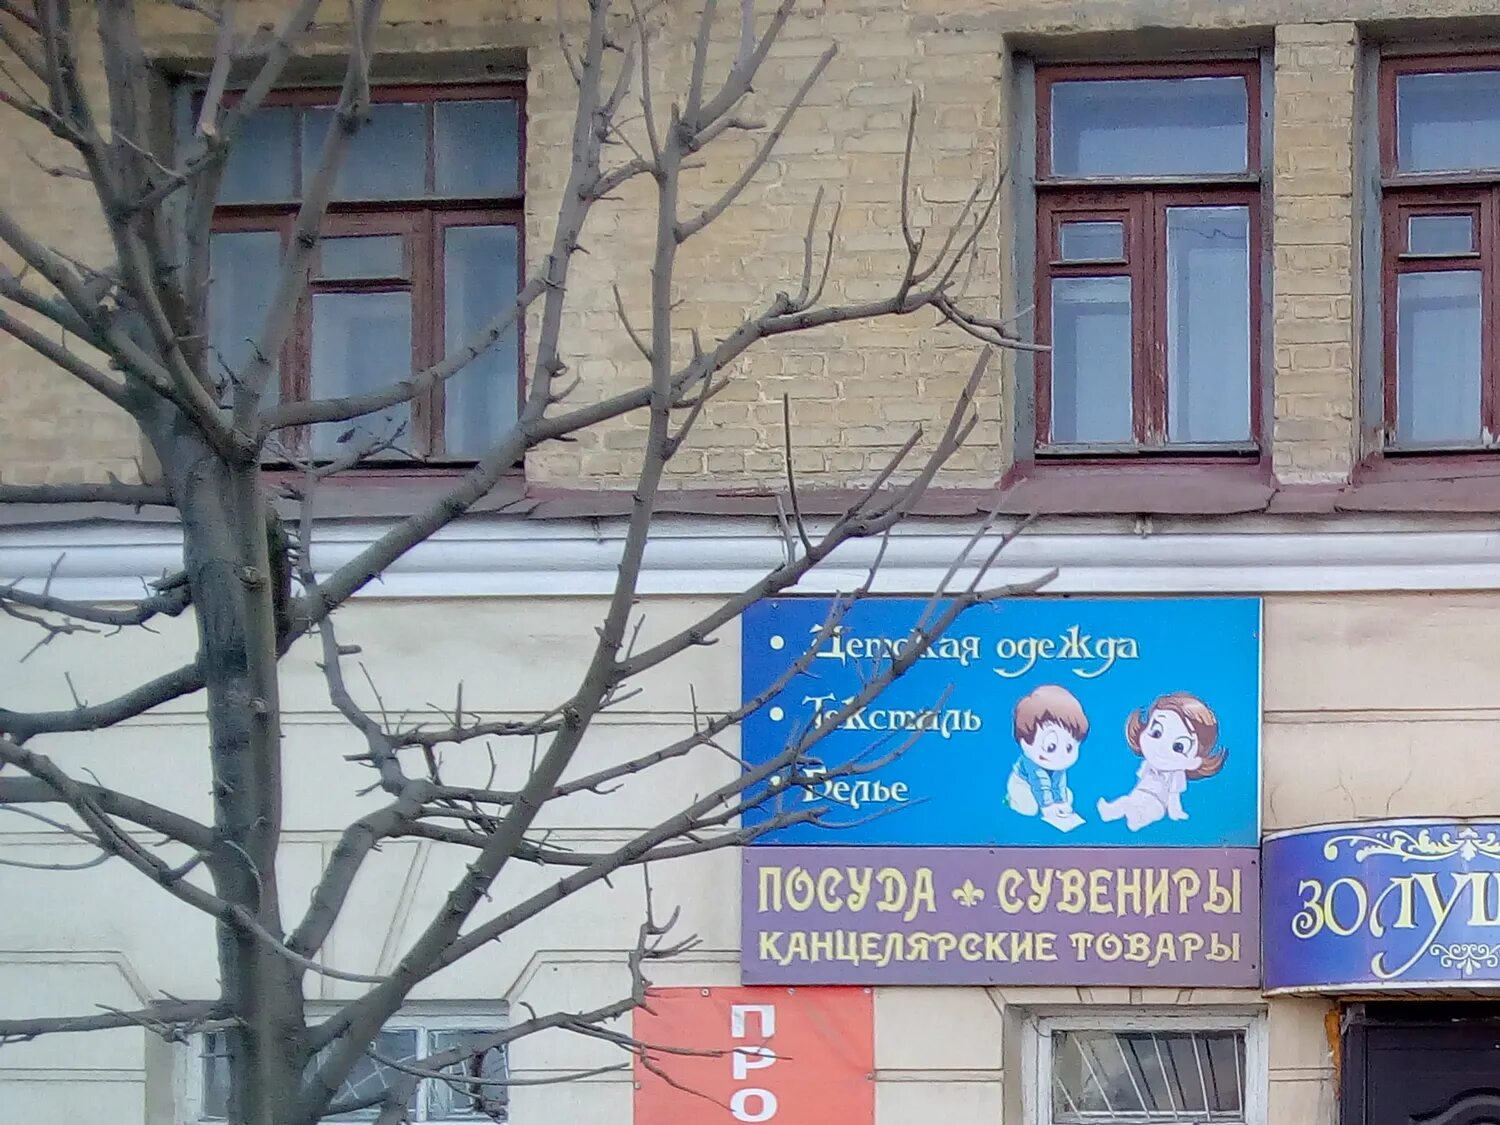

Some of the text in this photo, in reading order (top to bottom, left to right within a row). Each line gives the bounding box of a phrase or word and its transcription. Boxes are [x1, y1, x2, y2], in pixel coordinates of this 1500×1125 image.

[993, 624, 1140, 677] одежда
[757, 866, 1242, 922] ПОСУДА СУВЕНИРЫ
[758, 931, 1241, 968] КАНЦЕЛЯРСКИЕ ТОВАРЫ
